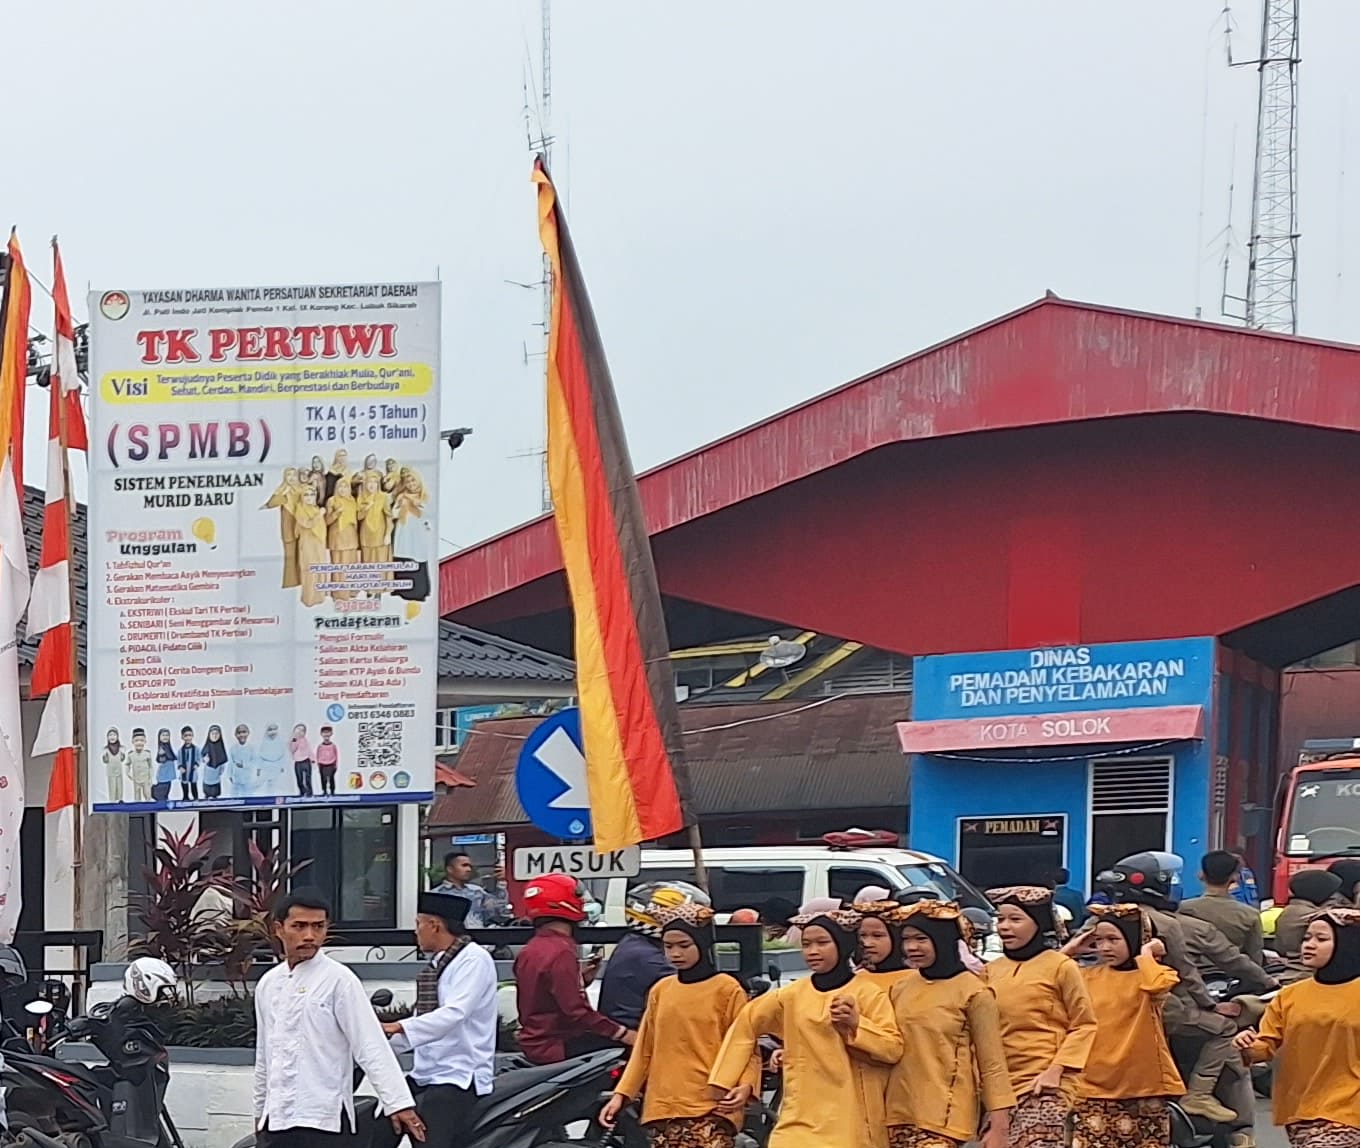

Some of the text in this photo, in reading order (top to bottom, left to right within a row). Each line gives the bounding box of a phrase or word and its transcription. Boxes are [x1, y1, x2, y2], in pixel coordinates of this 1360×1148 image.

[142, 284, 418, 303] YAYASAN DHARMA WANITA PERSATUAN SEKRETARIAT DAERAH
[137, 323, 398, 364] TK PERTIWI
[217, 372, 253, 382] Peserta
[280, 371, 302, 382] yang
[111, 377, 149, 396] Visi
[332, 381, 350, 391] dan
[350, 380, 400, 392] Berbudaya
[305, 406, 324, 420] TK
[327, 406, 337, 420] A
[379, 404, 418, 420] Tahun
[305, 426, 324, 440] TK
[327, 426, 337, 440] B
[379, 424, 418, 440] Tahun
[114, 473, 265, 491] SISTEM PENERIMAAN
[144, 492, 235, 508] MURID BARU
[105, 529, 183, 543] Program
[120, 543, 197, 556] Unggulan
[315, 616, 400, 629] Pendaftaran
[1030, 648, 1091, 669] DINAS
[950, 659, 1184, 692] PEMADAM KEBAKARAN
[961, 678, 1167, 707] DAN PENYELAMATAN
[980, 716, 1111, 742] KOTA SOLOK
[984, 820, 1040, 834] PEMADAM
[527, 850, 625, 874] MASUK
